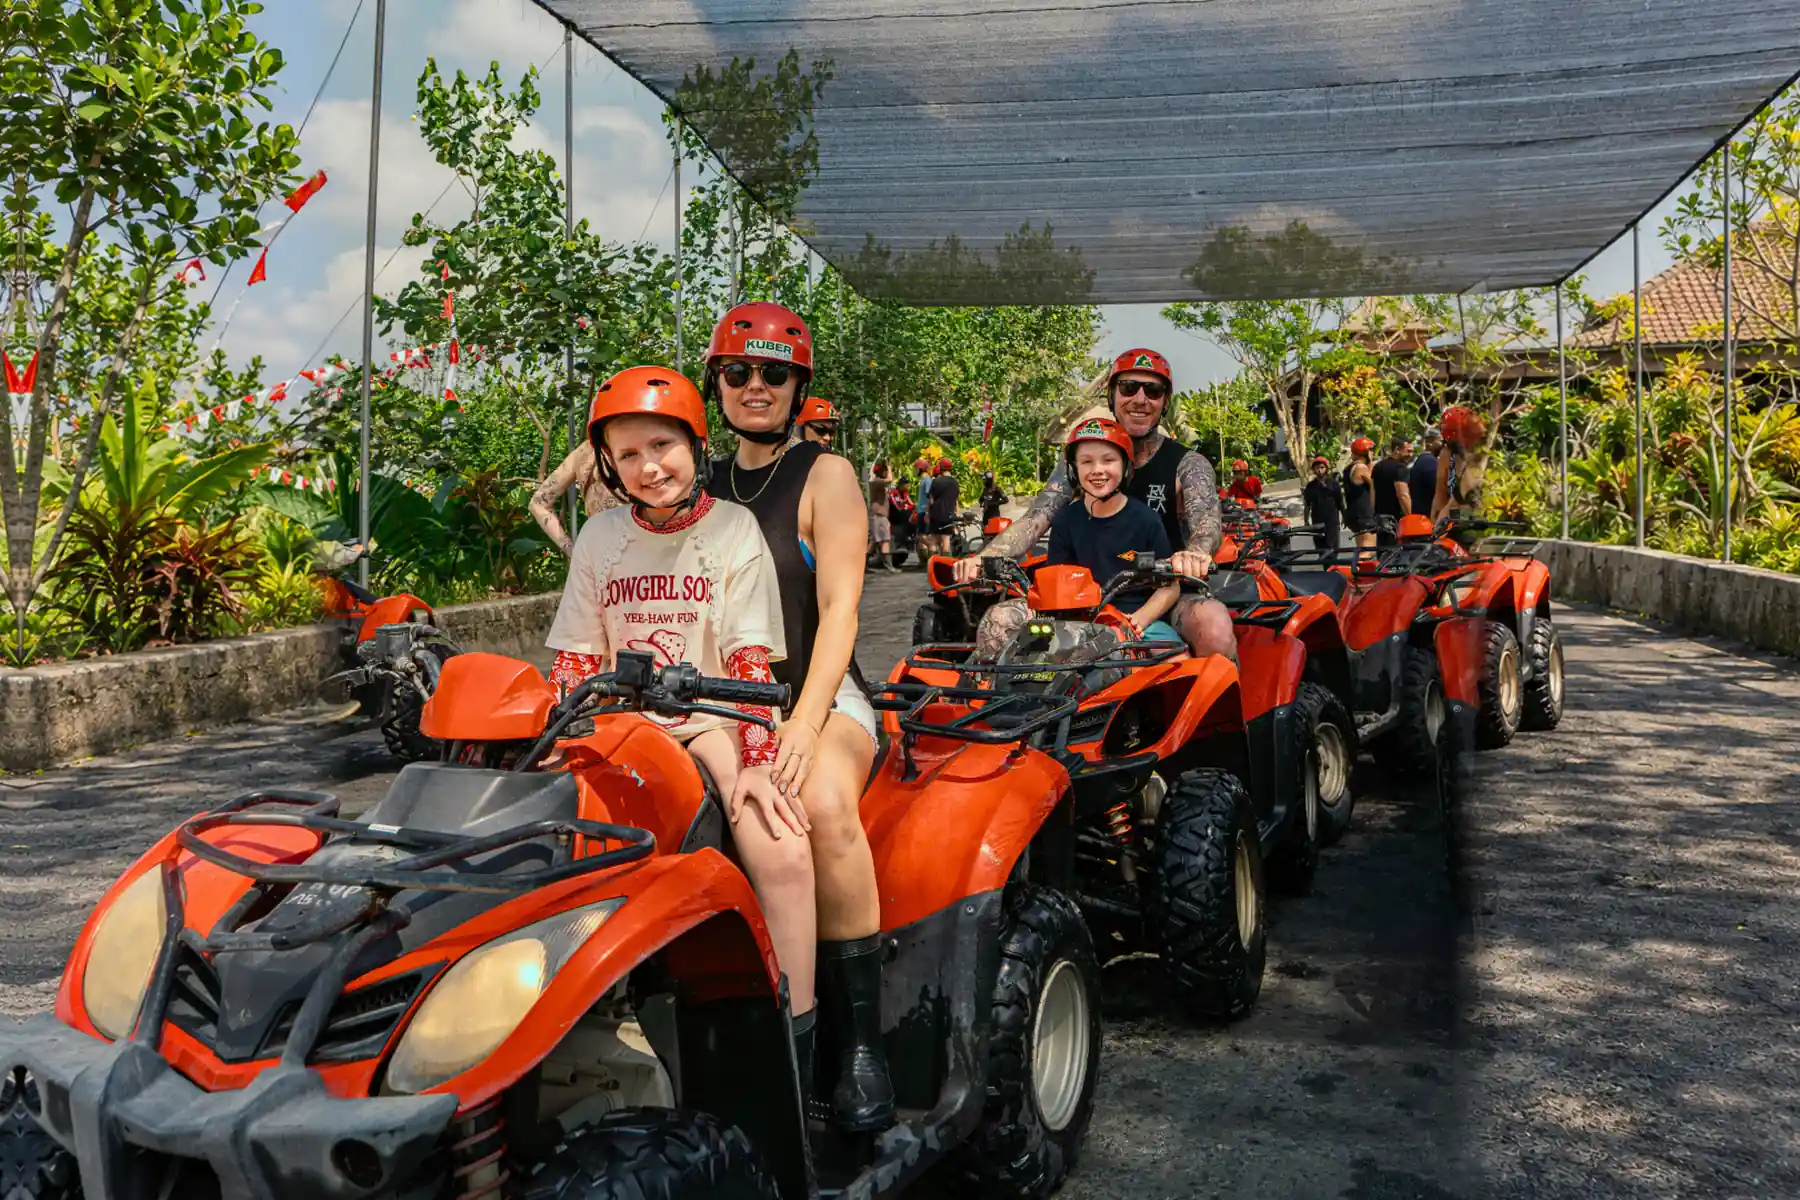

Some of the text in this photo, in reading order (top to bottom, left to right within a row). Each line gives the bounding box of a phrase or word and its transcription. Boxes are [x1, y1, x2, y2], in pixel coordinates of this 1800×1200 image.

[746, 340, 792, 354] KUBER
[623, 612, 699, 624] YEE-HAW FUN
